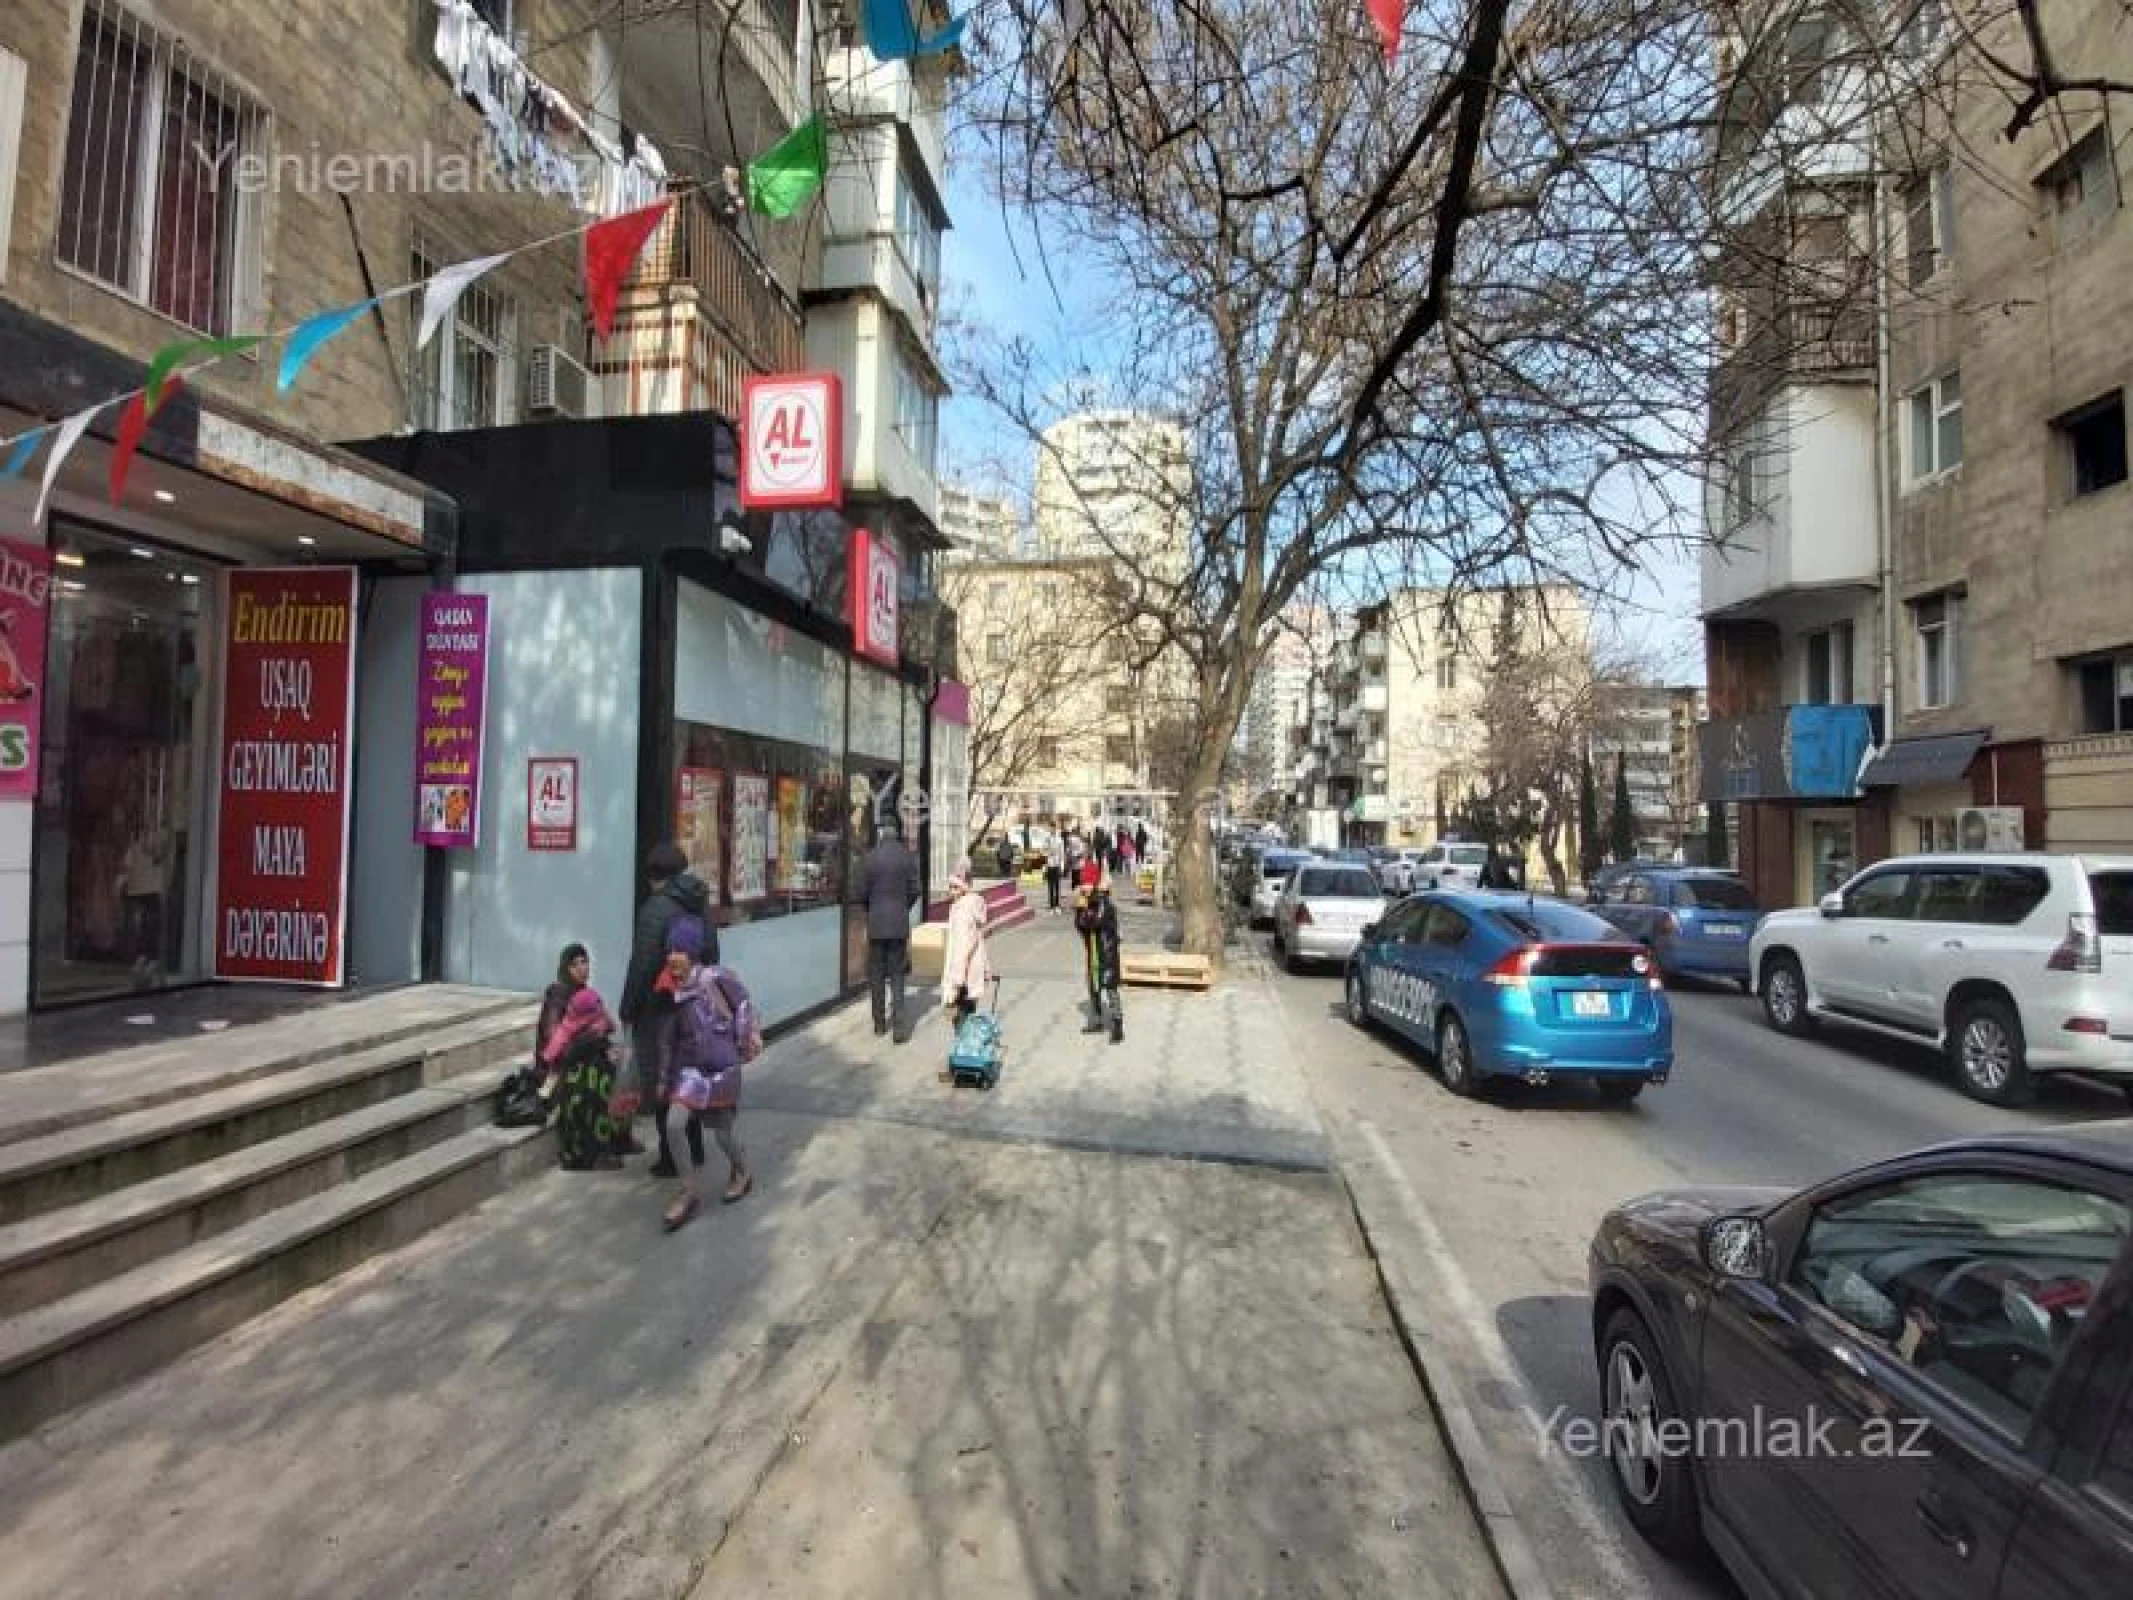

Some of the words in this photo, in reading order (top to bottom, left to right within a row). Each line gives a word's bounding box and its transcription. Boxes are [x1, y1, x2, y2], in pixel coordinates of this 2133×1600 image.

[764, 404, 812, 449] AL
[234, 591, 345, 643] Endirim
[874, 569, 892, 615] AL
[260, 658, 313, 722] UŞAQ
[228, 729, 338, 793] GEYİMLƏRİ
[539, 775, 567, 801] AL
[252, 825, 305, 876] MAYA
[224, 898, 329, 963] DƏYƏRİNƏ
